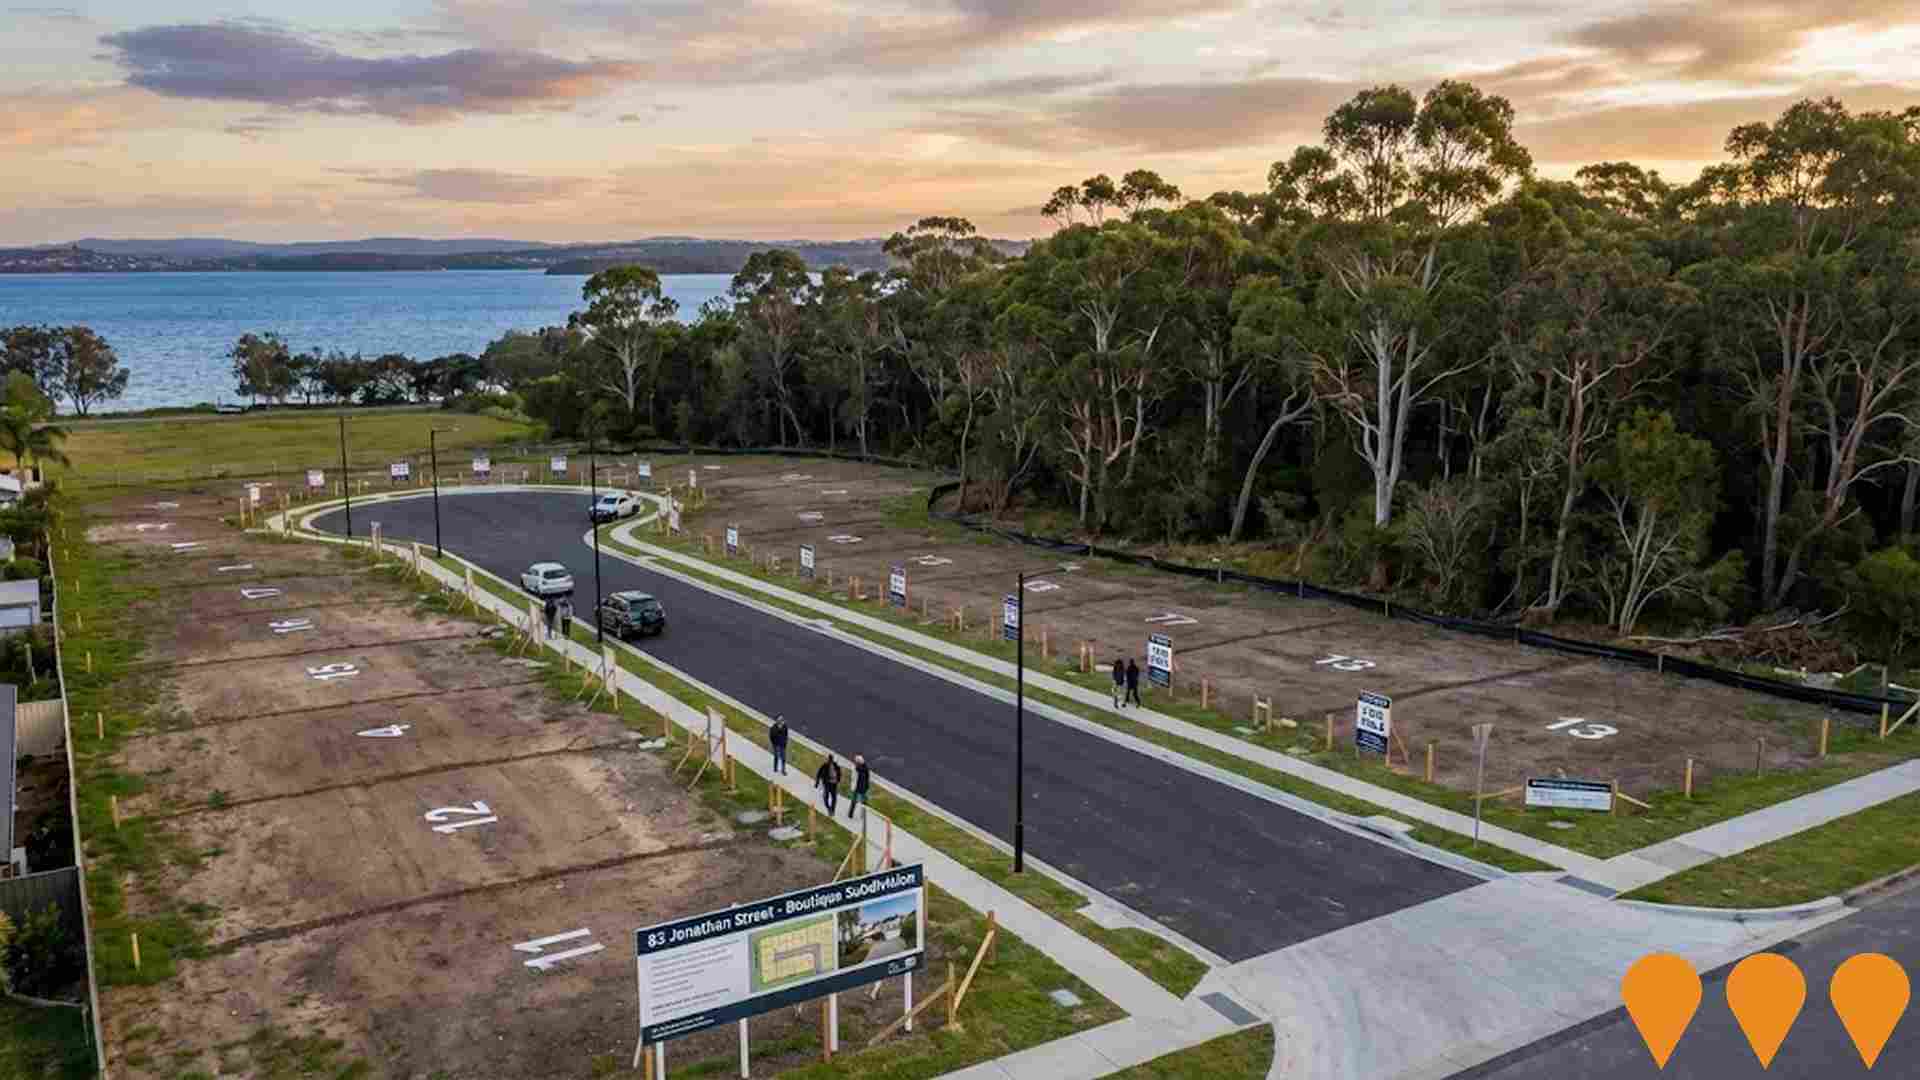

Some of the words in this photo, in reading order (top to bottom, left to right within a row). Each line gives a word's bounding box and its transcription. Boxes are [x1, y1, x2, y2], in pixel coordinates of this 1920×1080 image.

[1545, 716, 1619, 740] 13
[424, 800, 499, 834] 12
[647, 931, 667, 948] 83
[669, 918, 732, 942] Jonathan
[734, 905, 775, 927] Street
[785, 889, 843, 914] Boutique
